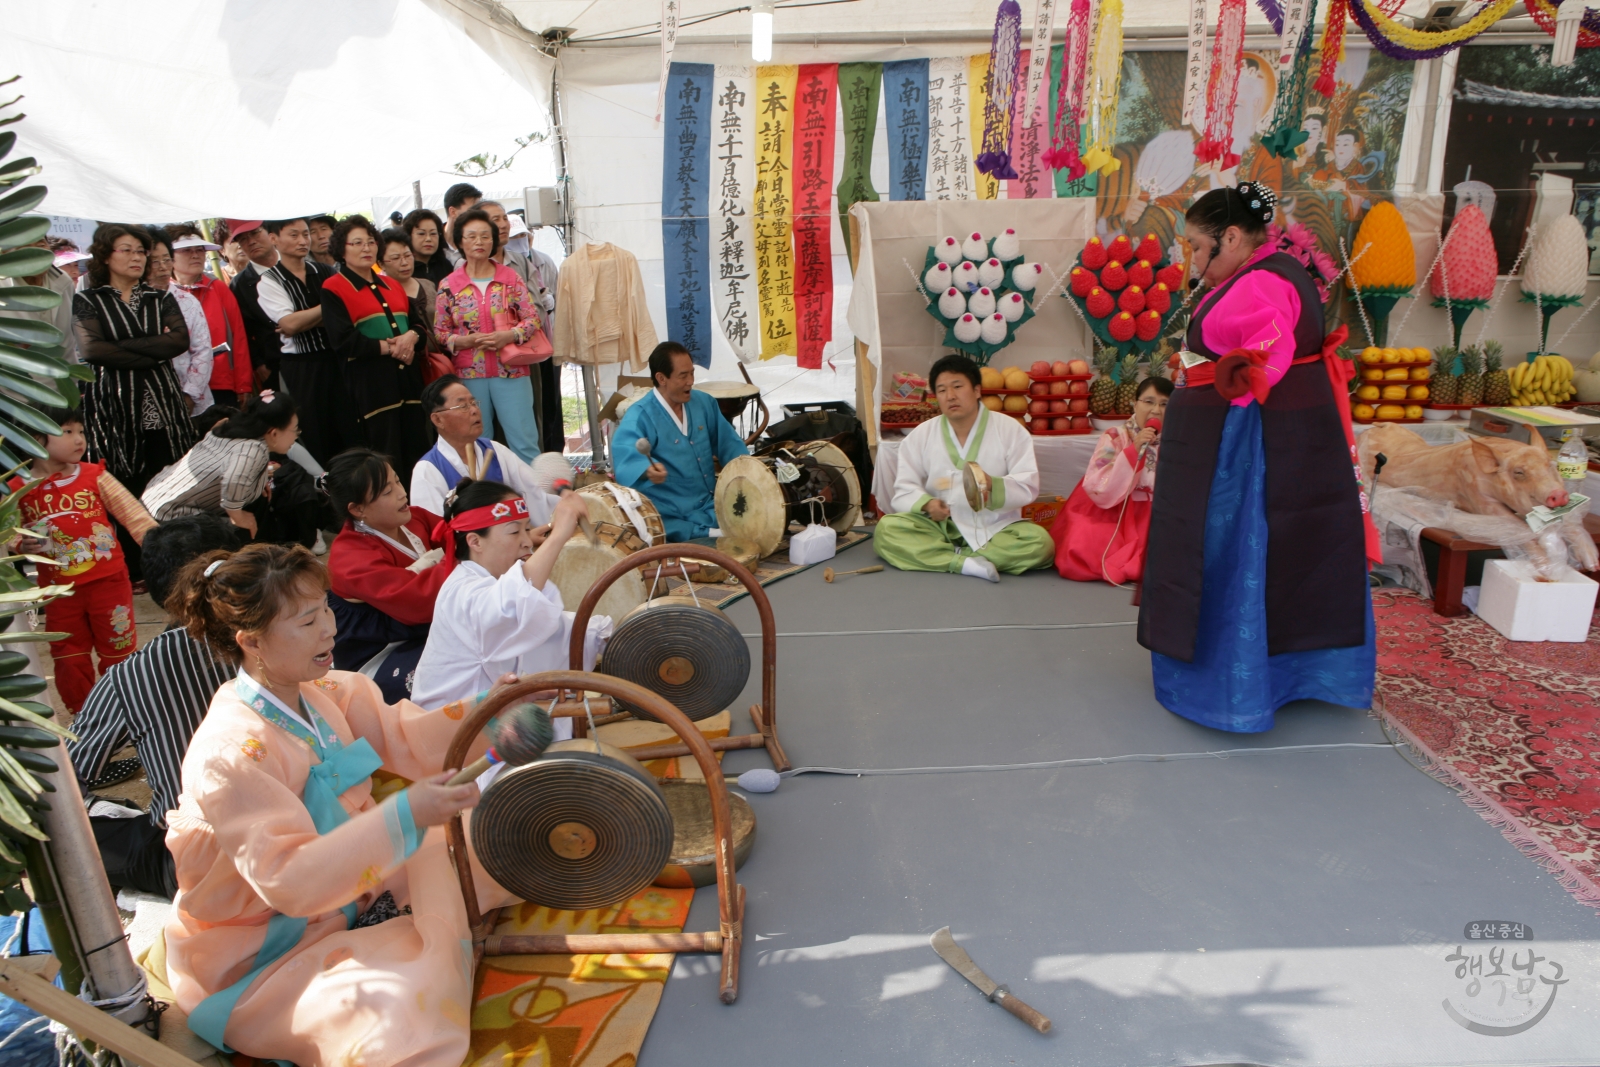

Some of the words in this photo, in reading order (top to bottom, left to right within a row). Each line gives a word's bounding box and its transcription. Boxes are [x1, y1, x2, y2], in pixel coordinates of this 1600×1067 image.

[1031, 0, 1052, 107] 奉請第二初江大
[53, 224, 83, 233] TOILET
[766, 318, 792, 340] 位
